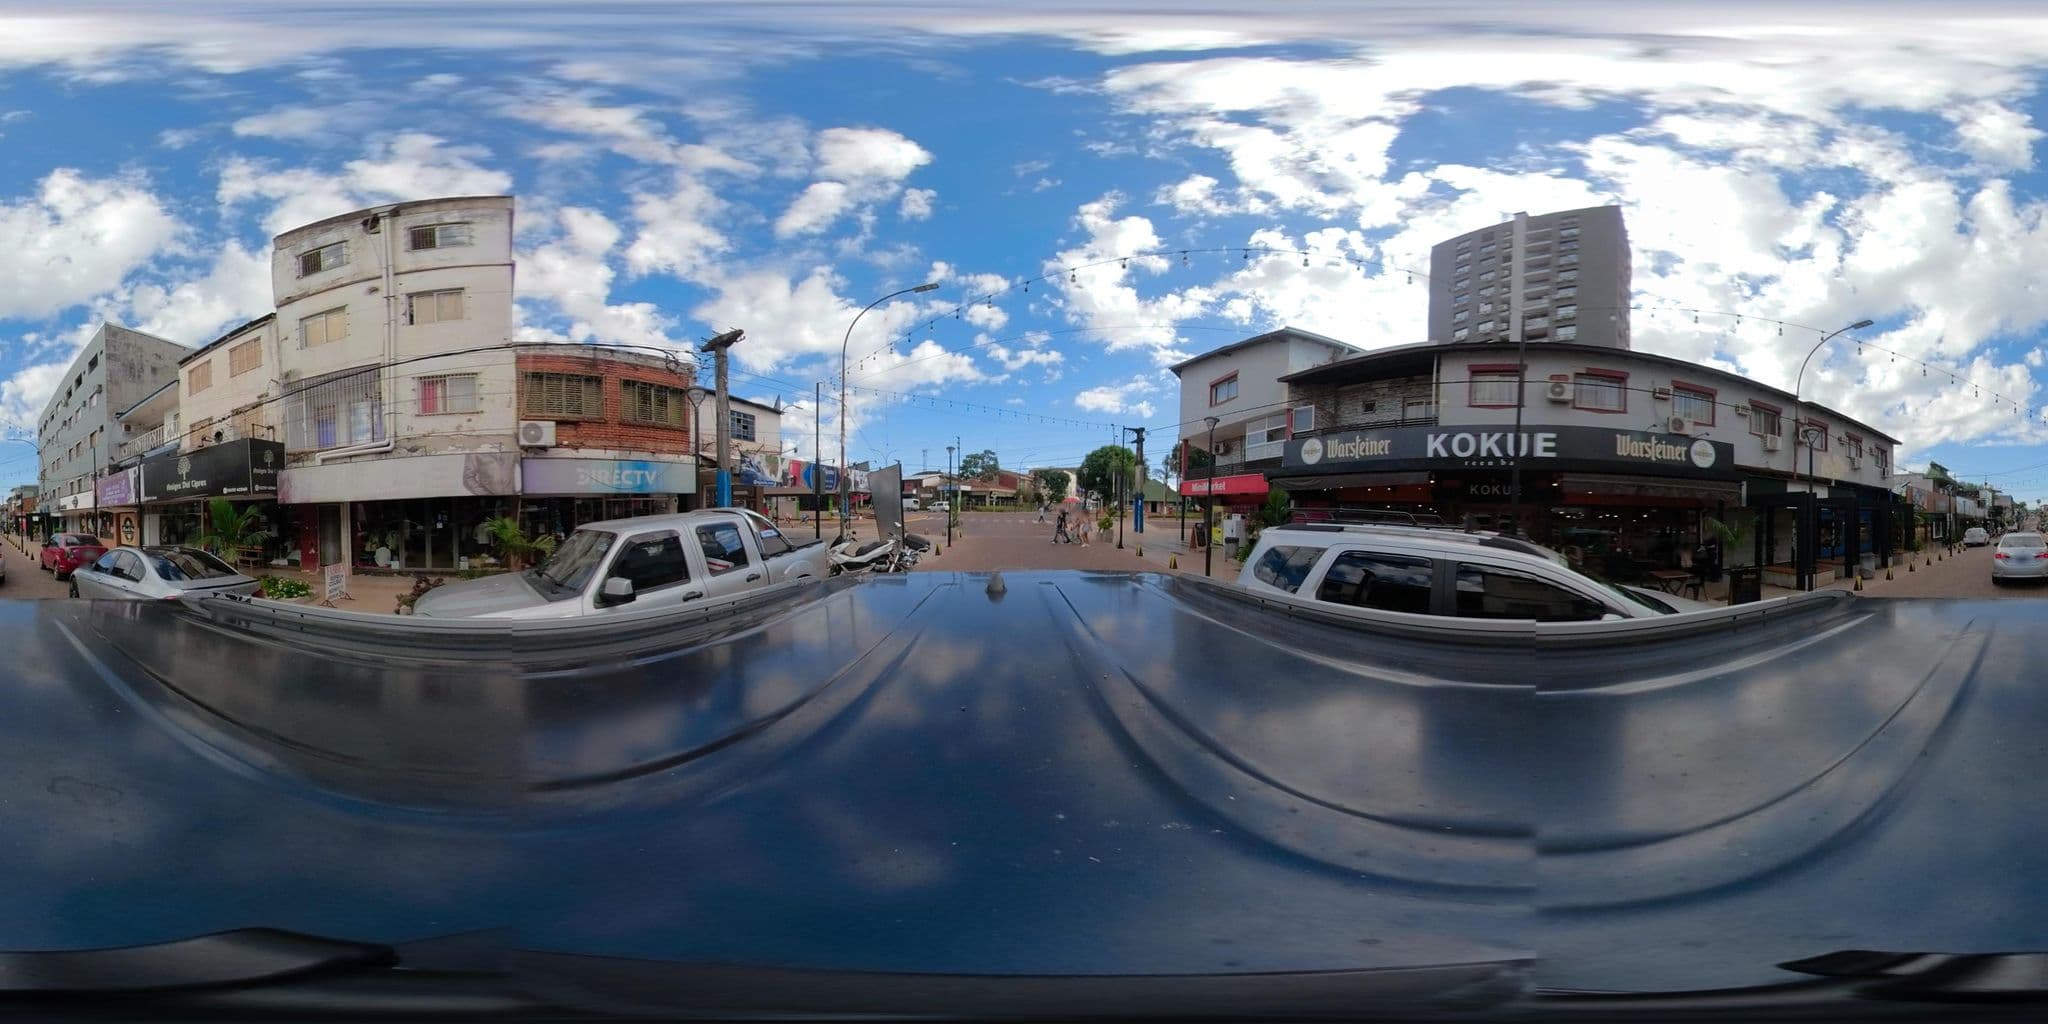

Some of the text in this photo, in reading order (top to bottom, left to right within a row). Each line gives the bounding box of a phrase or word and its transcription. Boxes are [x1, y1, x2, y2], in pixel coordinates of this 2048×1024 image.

[1327, 435, 1391, 459] Warsteiner
[1427, 433, 1558, 458] KOKUE
[1616, 434, 1688, 461] Warsteiner
[577, 467, 658, 486] DIRECTV
[1191, 481, 1226, 492] MiniMrket
[1469, 484, 1522, 496] KOKU
